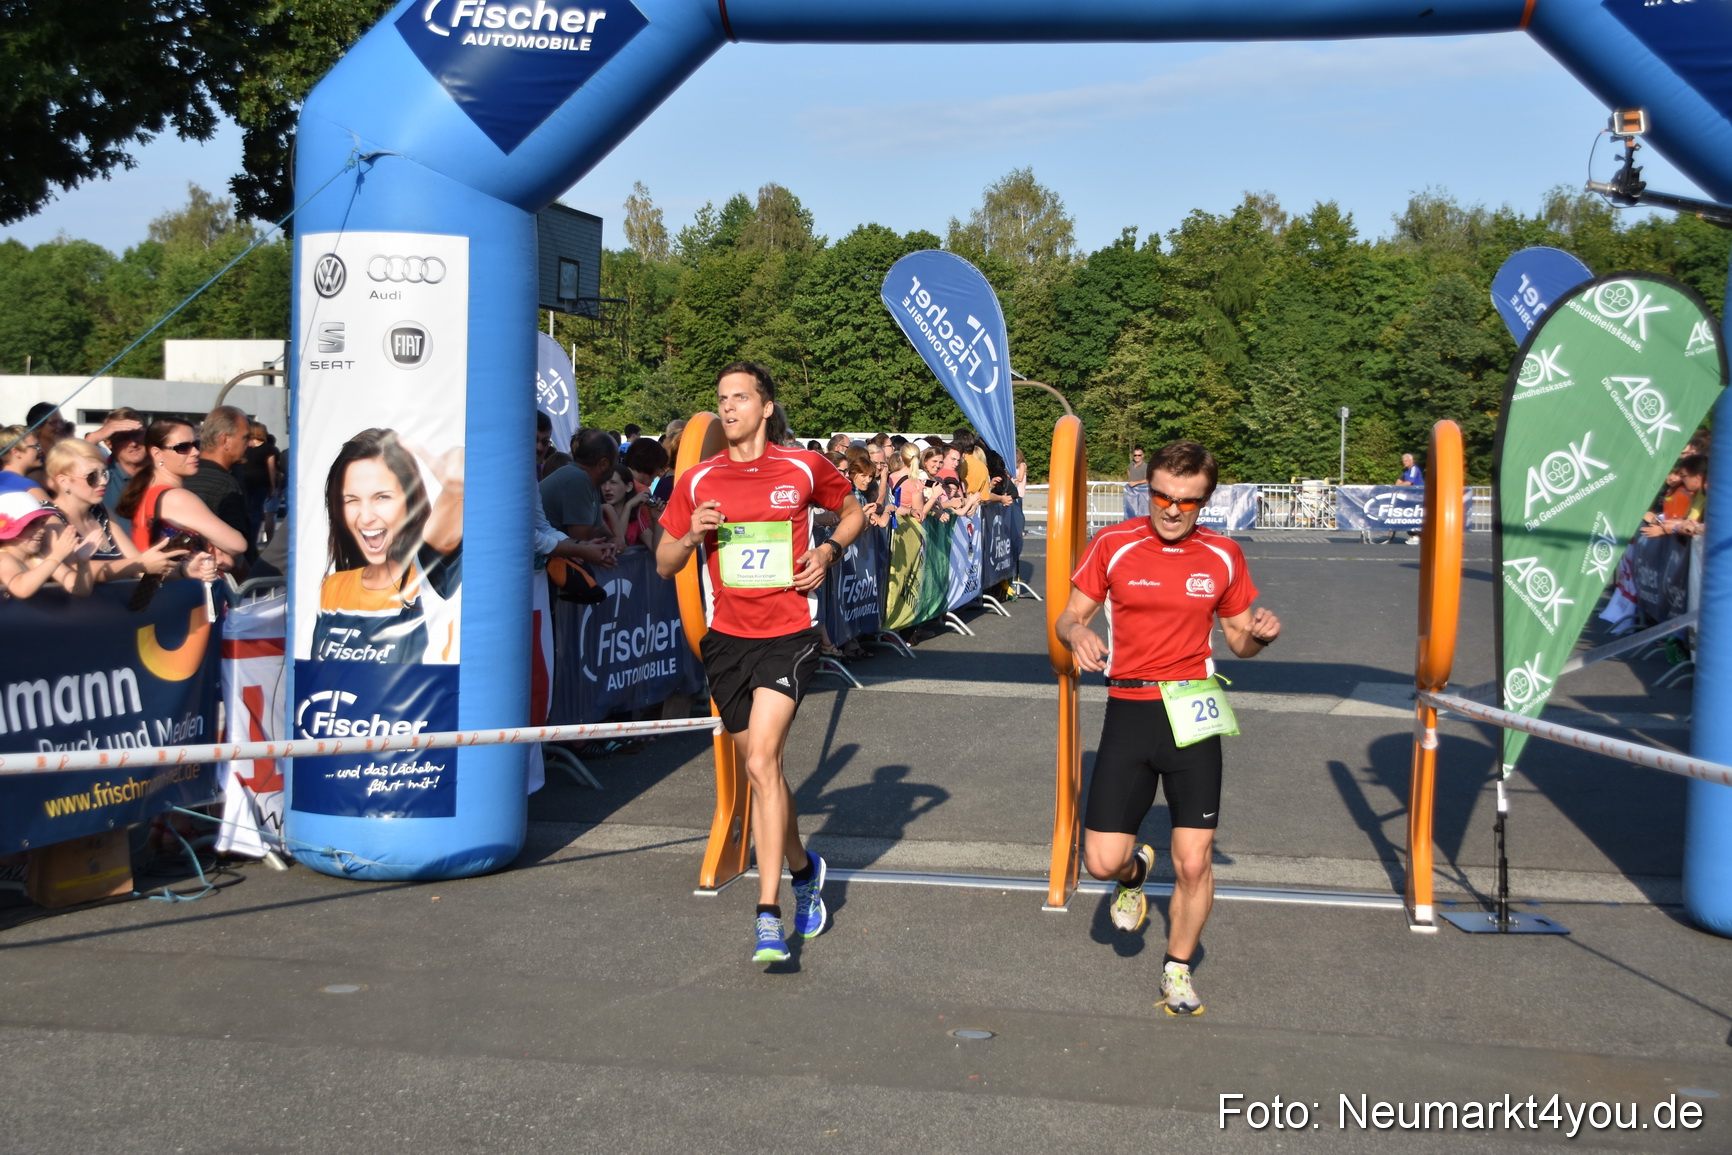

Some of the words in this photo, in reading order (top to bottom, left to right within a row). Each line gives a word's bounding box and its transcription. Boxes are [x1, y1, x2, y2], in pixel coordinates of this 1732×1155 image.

[452, 0, 606, 34] Fischer
[463, 33, 592, 51] AUTOMOBILE
[369, 290, 402, 300] Audi
[395, 334, 422, 356] FIAT
[310, 361, 355, 370] SEAT
[1601, 377, 1612, 391] Die
[1610, 376, 1681, 451] AOK
[1524, 431, 1610, 519] AOK
[1525, 516, 1540, 532] Die
[1539, 472, 1617, 520] Gesundheitskasse.
[741, 549, 770, 569] 27
[1585, 516, 1617, 583] AOK
[1502, 557, 1574, 627] AOK
[325, 640, 396, 664] Fischer
[598, 613, 680, 667] Fischer
[607, 658, 677, 692] AUTOMOBILE
[1191, 696, 1219, 722] 28
[155, 712, 204, 747] Medien
[313, 711, 428, 738] Fischer
[337, 764, 361, 779] und
[364, 761, 388, 776] das
[366, 779, 404, 797] fährt
[408, 776, 440, 790] mit!
